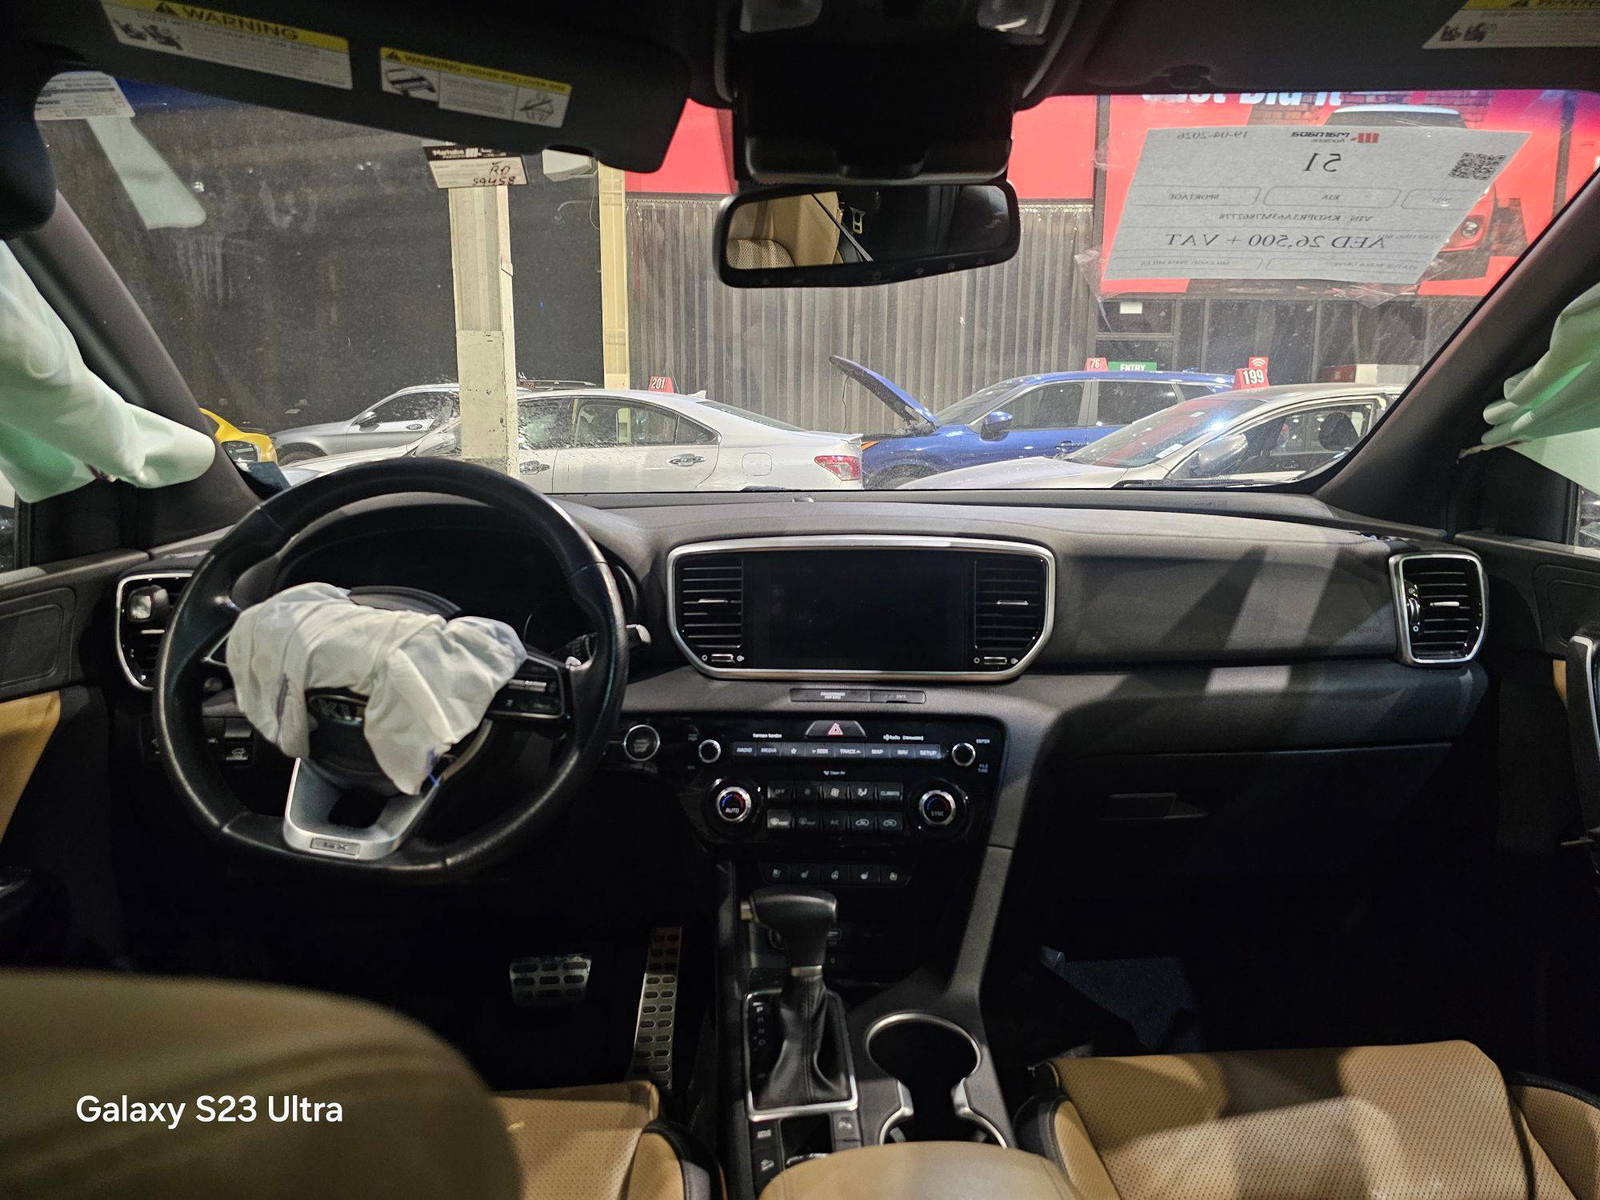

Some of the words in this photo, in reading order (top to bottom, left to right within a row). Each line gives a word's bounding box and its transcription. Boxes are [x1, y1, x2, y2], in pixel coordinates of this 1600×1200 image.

[185, 5, 298, 41] WARNING
[1090, 359, 1100, 368] 76
[1120, 363, 1146, 371] ENTRY
[1243, 369, 1264, 385] 199
[652, 377, 665, 390] 201
[725, 807, 740, 815] AUTO
